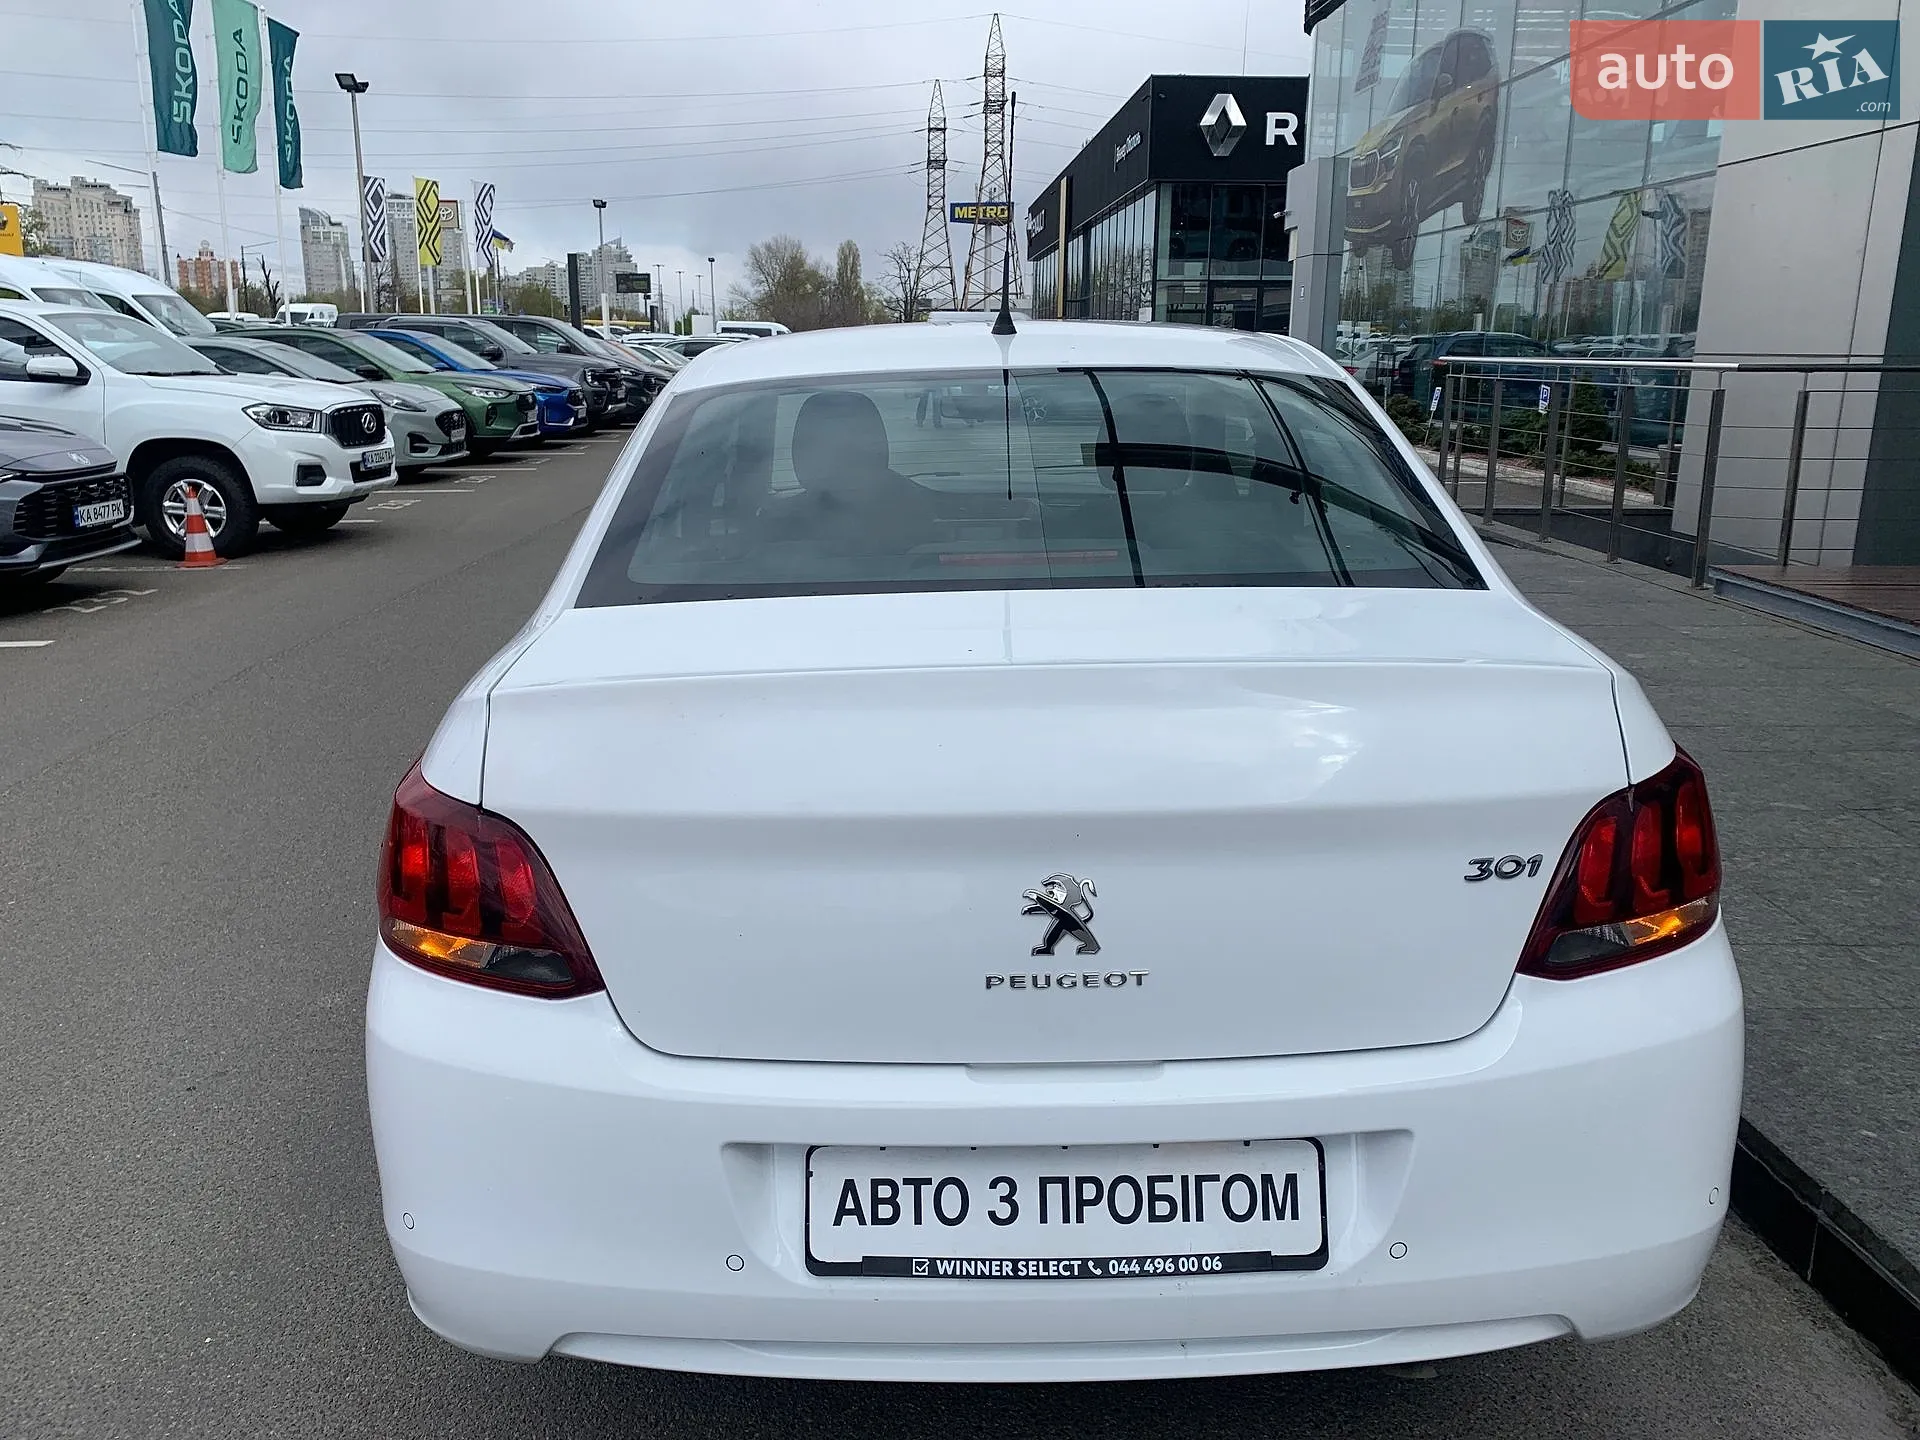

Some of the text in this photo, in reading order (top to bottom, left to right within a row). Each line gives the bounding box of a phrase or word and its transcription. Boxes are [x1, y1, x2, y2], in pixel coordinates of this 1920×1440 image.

[1265, 111, 1299, 146] R
[954, 205, 1009, 219] METRO
[79, 502, 123, 524] KA 8477 PK
[1463, 853, 1544, 882] 301
[985, 968, 1151, 990] PEUGEOT
[832, 1176, 970, 1227] АВТО
[1038, 1173, 1300, 1225] ПРОБІГОМ
[936, 1255, 1223, 1276] WINNER SELECT 044 496 00 06
